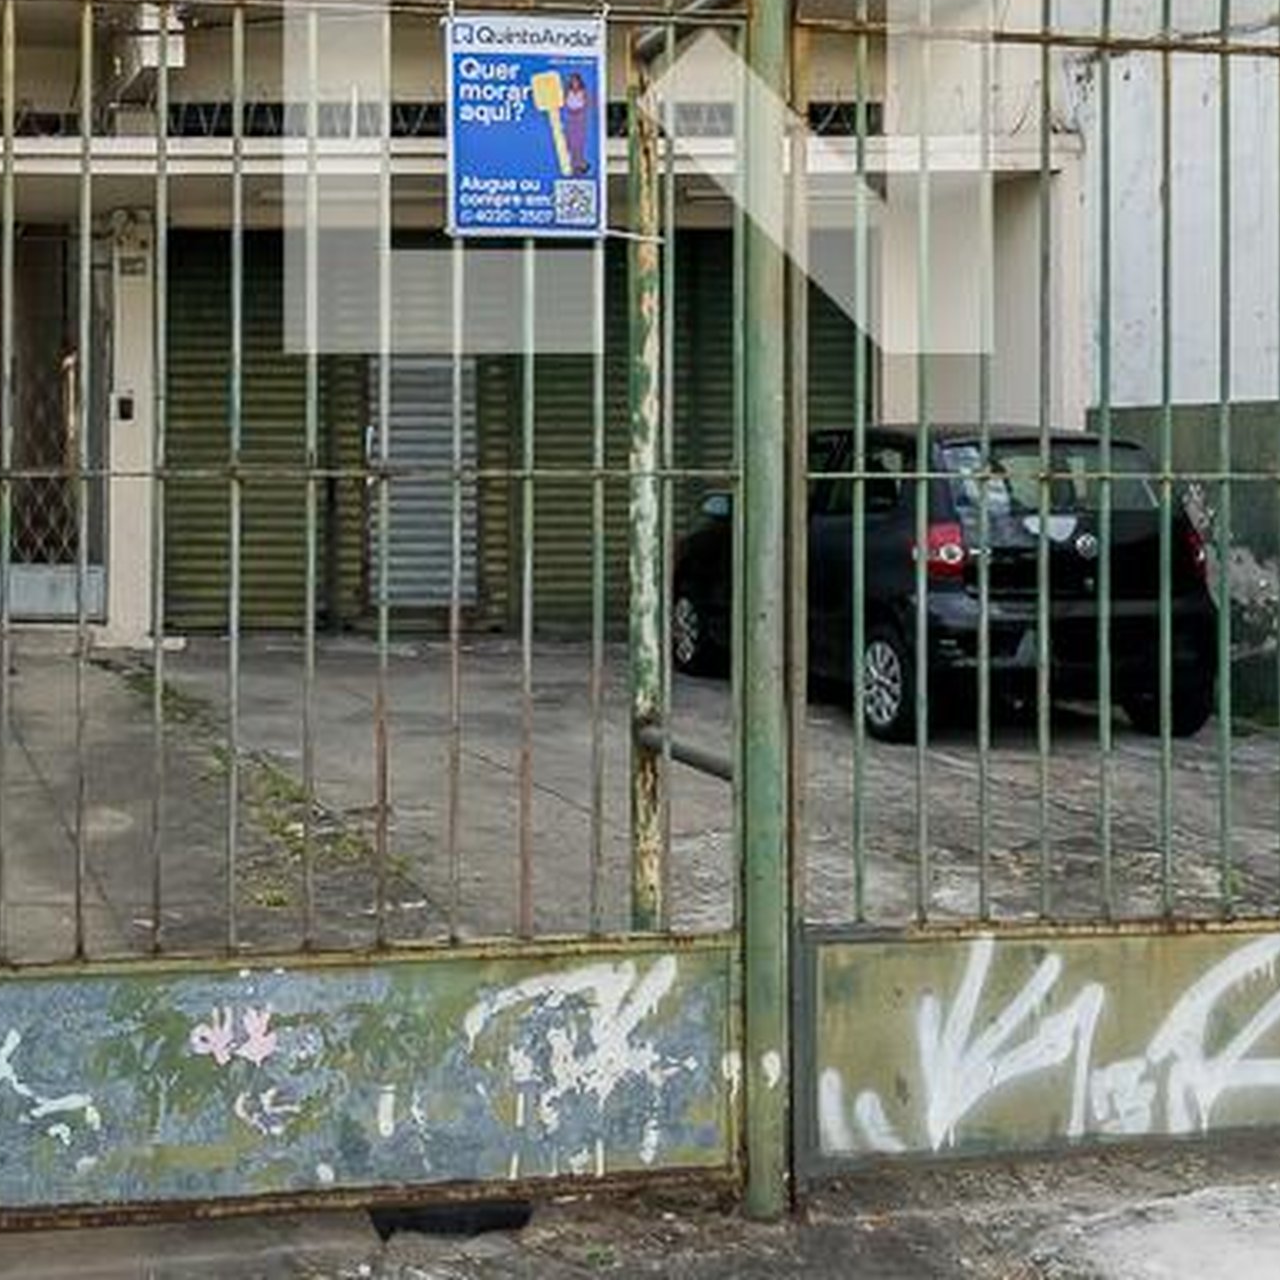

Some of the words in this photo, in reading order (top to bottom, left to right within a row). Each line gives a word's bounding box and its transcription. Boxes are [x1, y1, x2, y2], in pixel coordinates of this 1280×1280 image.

[476, 25, 598, 48] QuintoAndar
[458, 57, 521, 81] Quer
[459, 84, 532, 102] morar
[459, 102, 526, 125] aqui?
[459, 175, 517, 194] Alugue
[519, 178, 541, 192] ou
[459, 193, 522, 208] compre
